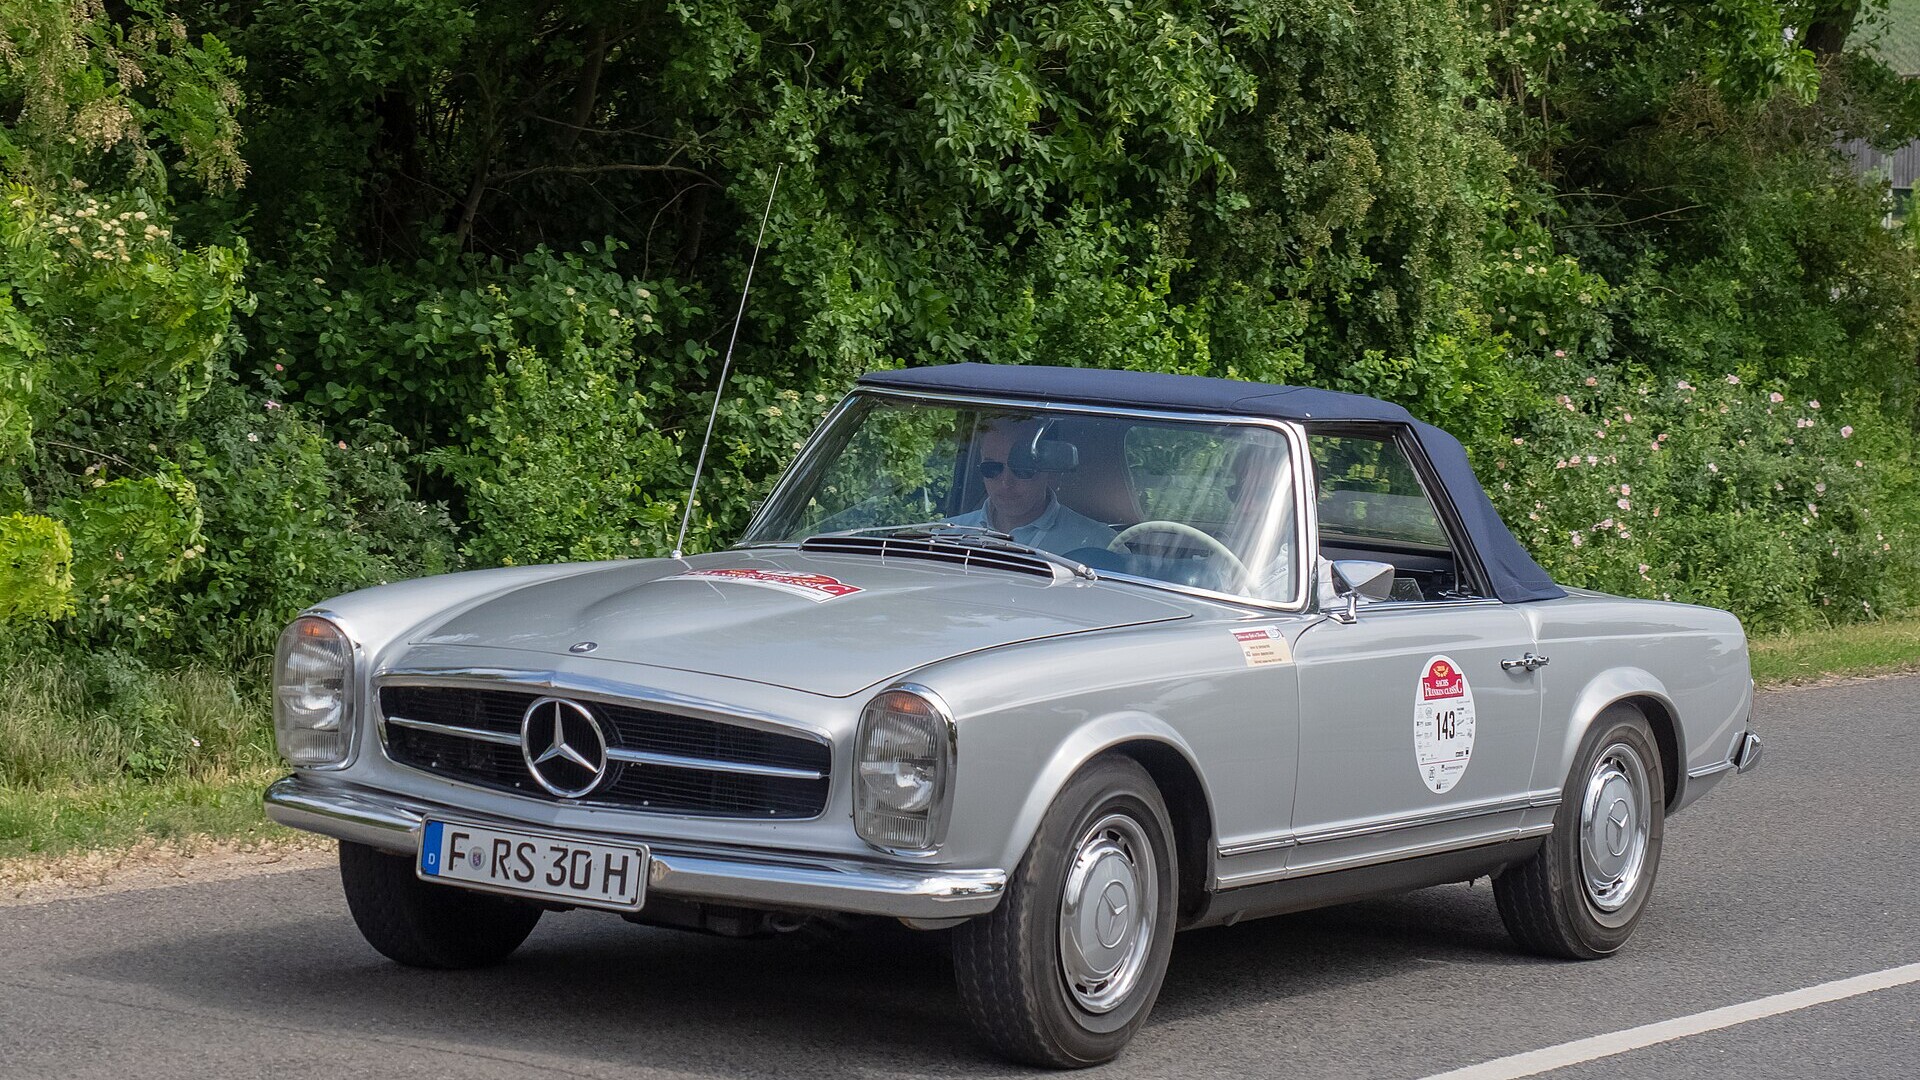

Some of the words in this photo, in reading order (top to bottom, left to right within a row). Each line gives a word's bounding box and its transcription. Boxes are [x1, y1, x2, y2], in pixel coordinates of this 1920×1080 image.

[1436, 710, 1455, 741] 143
[428, 852, 436, 866] D
[448, 831, 470, 871] F
[490, 838, 537, 883] RS
[545, 845, 593, 891] 30
[602, 853, 629, 896] H
